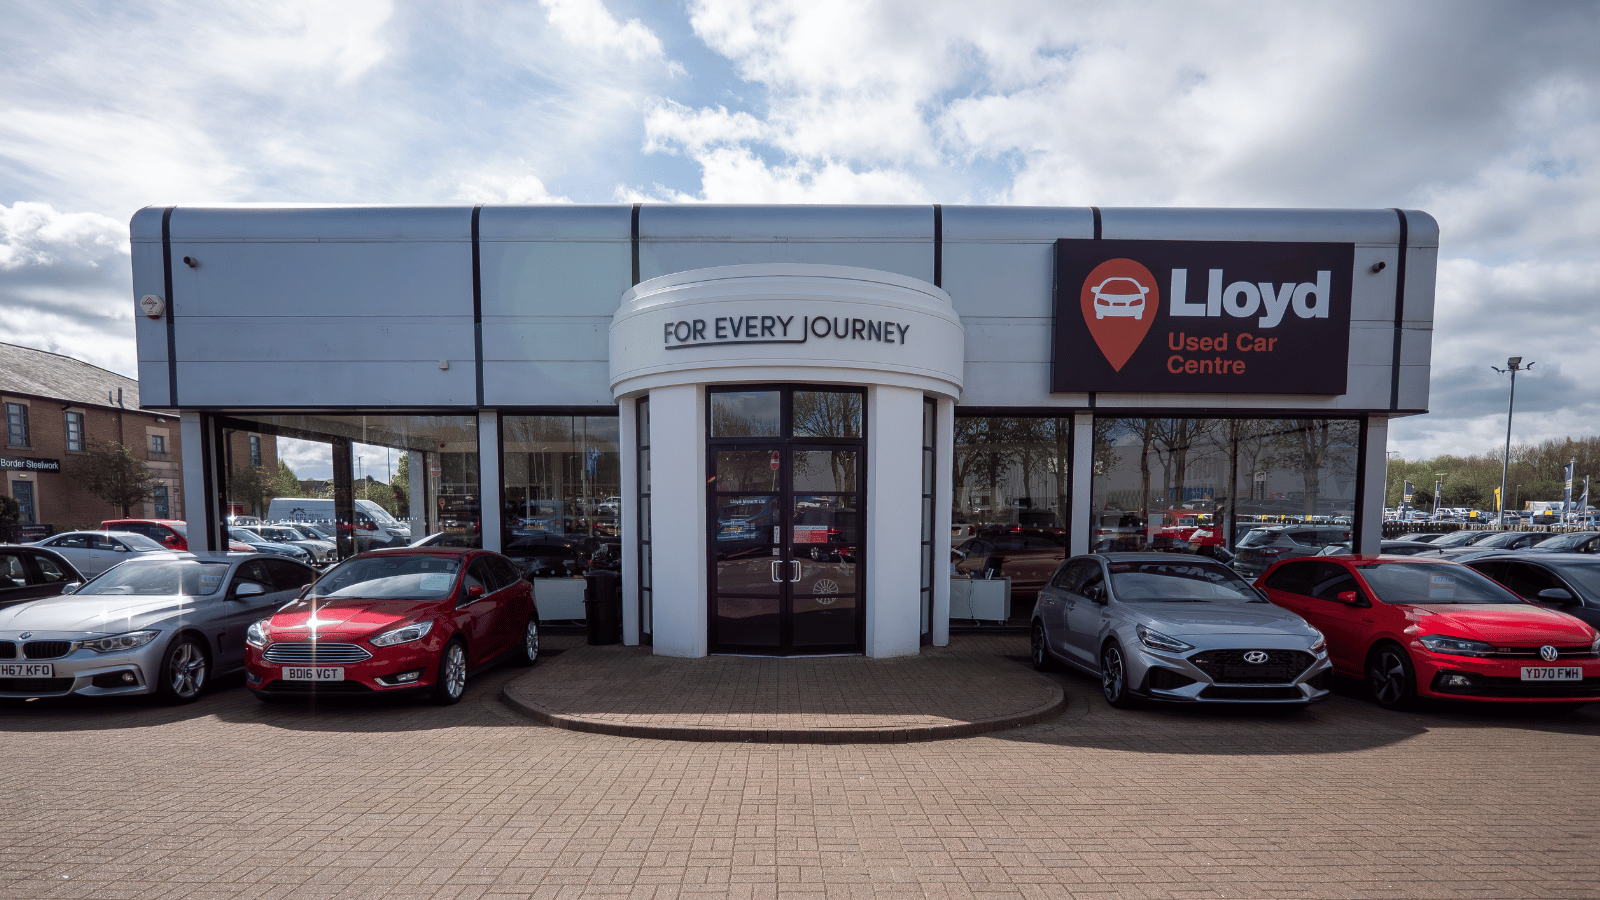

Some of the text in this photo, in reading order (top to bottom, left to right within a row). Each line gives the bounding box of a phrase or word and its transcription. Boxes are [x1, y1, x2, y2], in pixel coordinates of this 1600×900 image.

[1169, 268, 1332, 329] Lloyd
[664, 315, 910, 345] FOR EVERY JOURNEY
[1168, 332, 1278, 352] Used Car
[1167, 355, 1246, 375] Centre
[0, 458, 59, 470] Border Steelwork
[0, 664, 50, 676] H67 KFO
[289, 668, 338, 679] BD16 VGT
[1526, 668, 1579, 679] YD70 FWH
